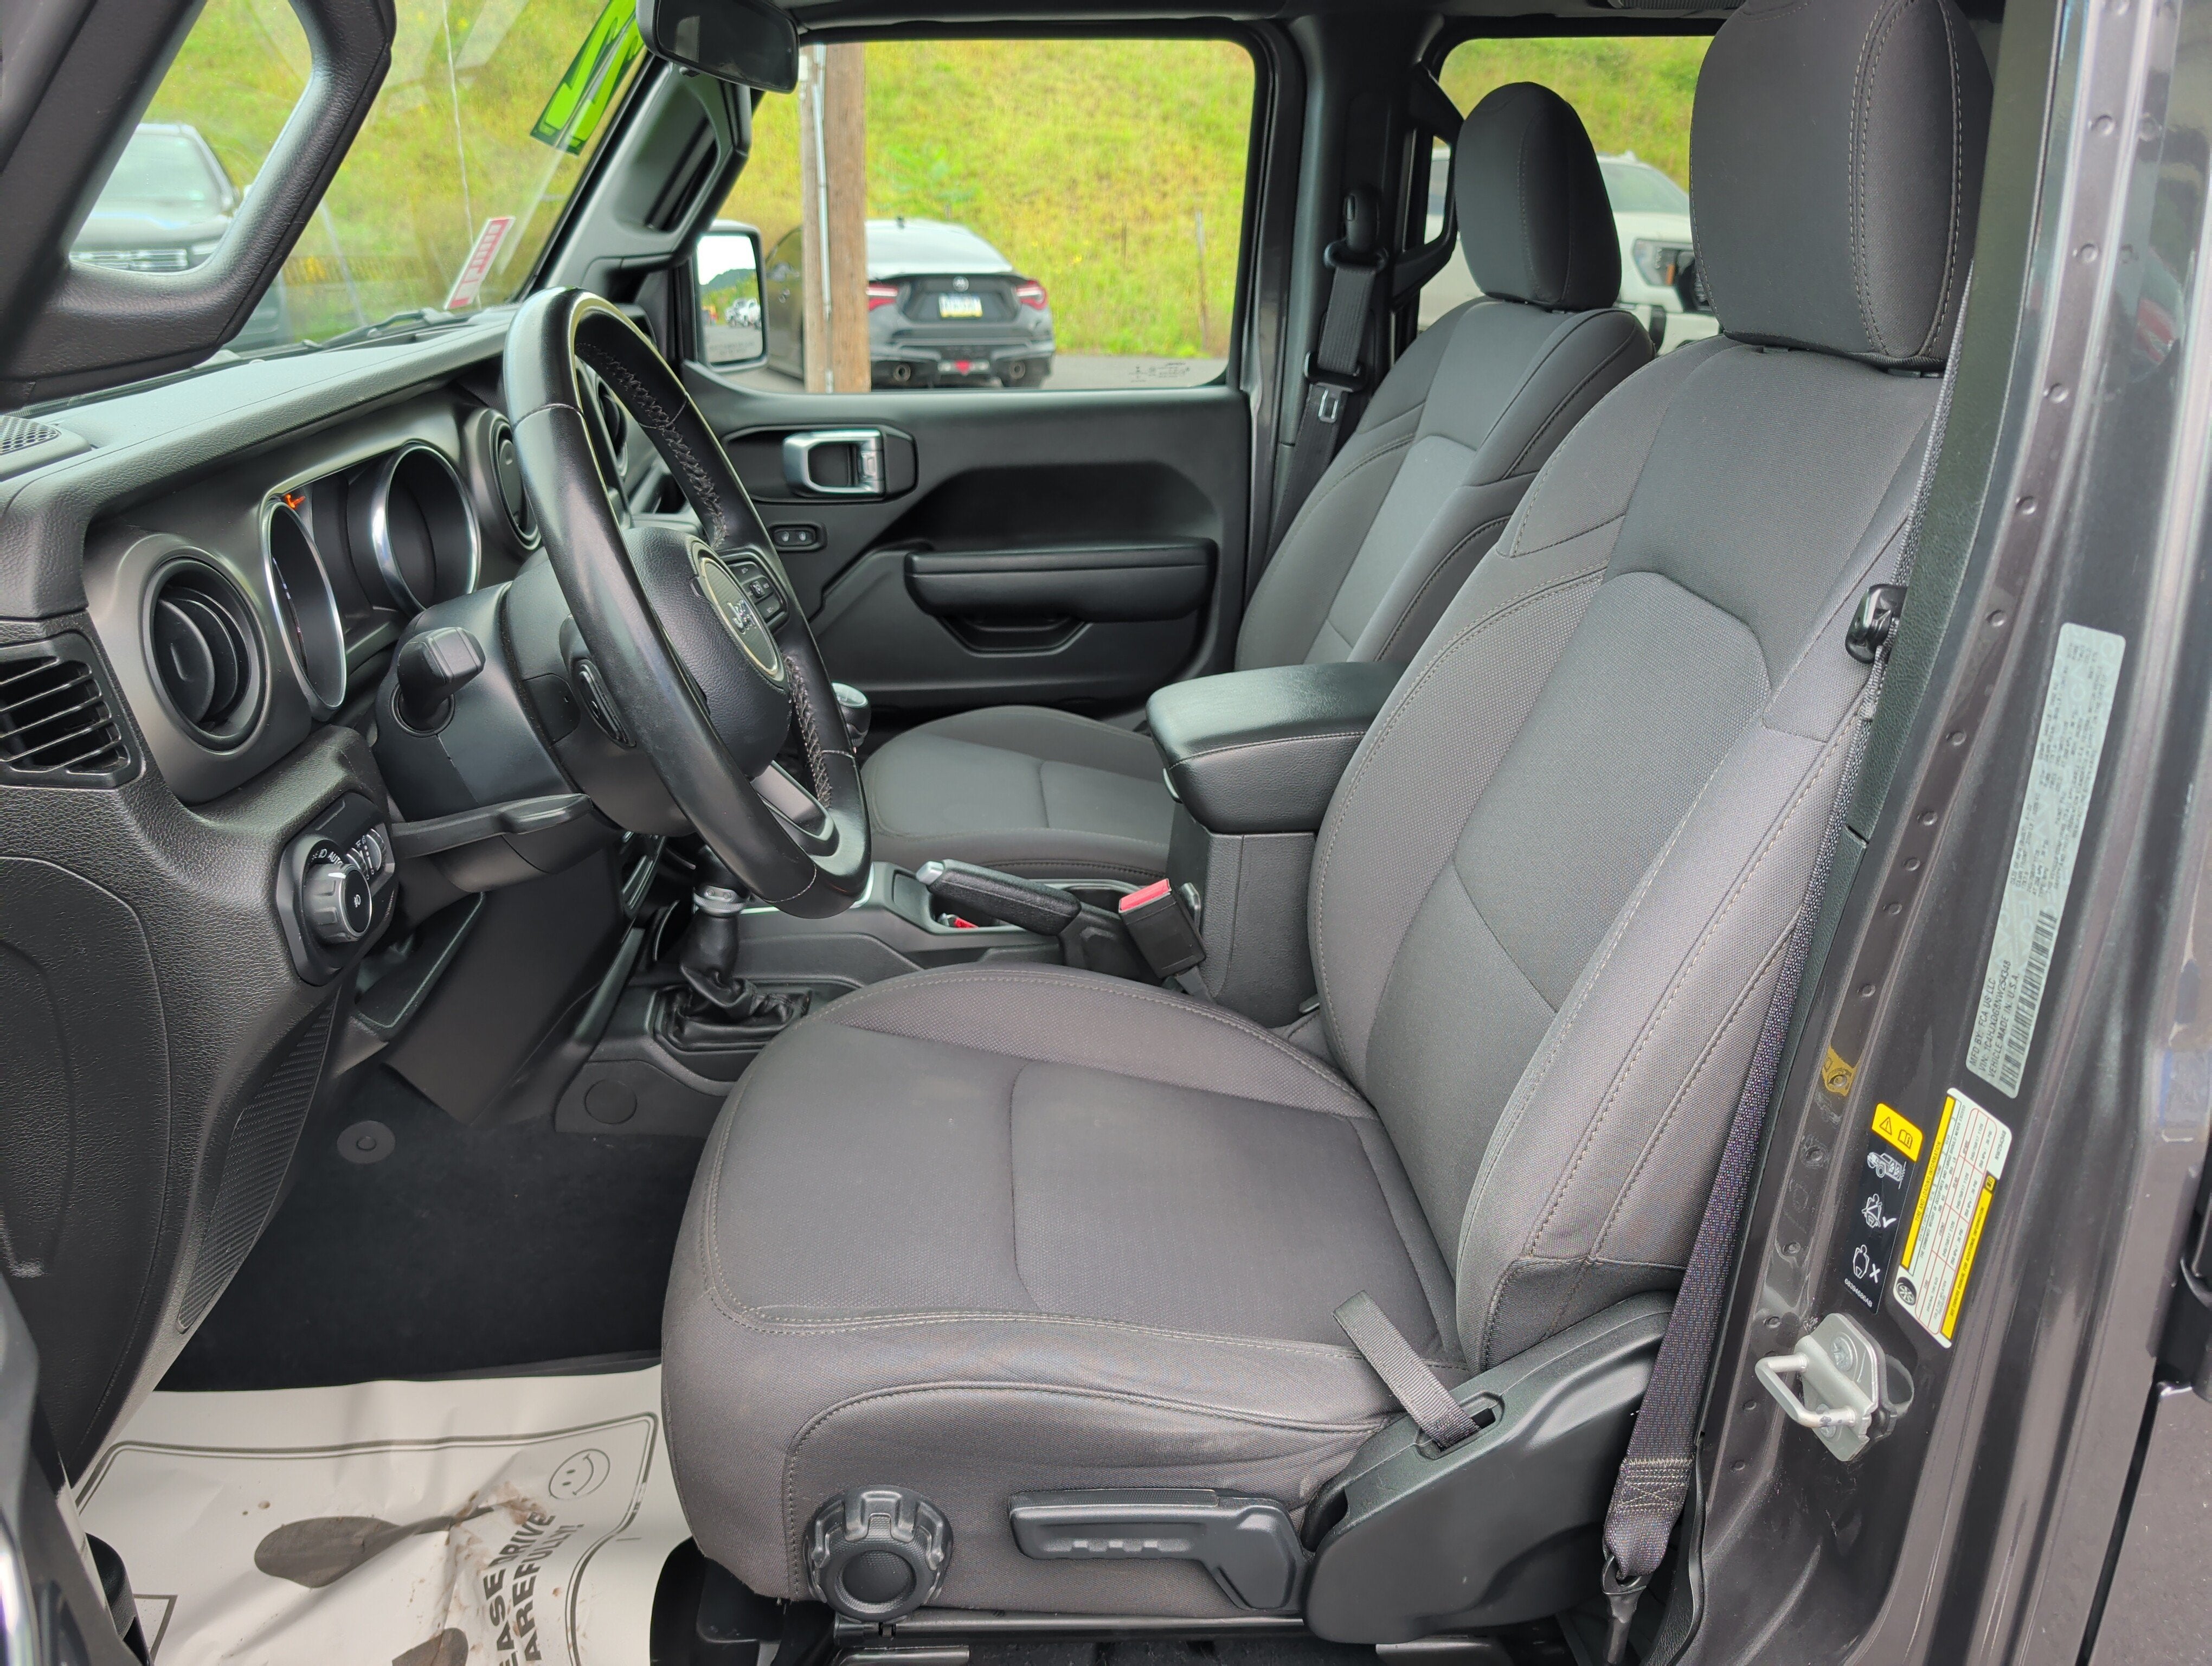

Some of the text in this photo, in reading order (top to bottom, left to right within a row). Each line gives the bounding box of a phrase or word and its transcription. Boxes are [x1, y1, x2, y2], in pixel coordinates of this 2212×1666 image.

[1969, 976, 1996, 1067] MFD BY: FCA US LLC
[1988, 970, 2020, 1079] VEHICLE MADE IN: U.S.A.
[1978, 1053, 1989, 1073] VIN:
[1921, 1175, 1931, 1199] LOADING
[1927, 1139, 1941, 1176] INFORMATION
[487, 1512, 556, 1567] DRIVE
